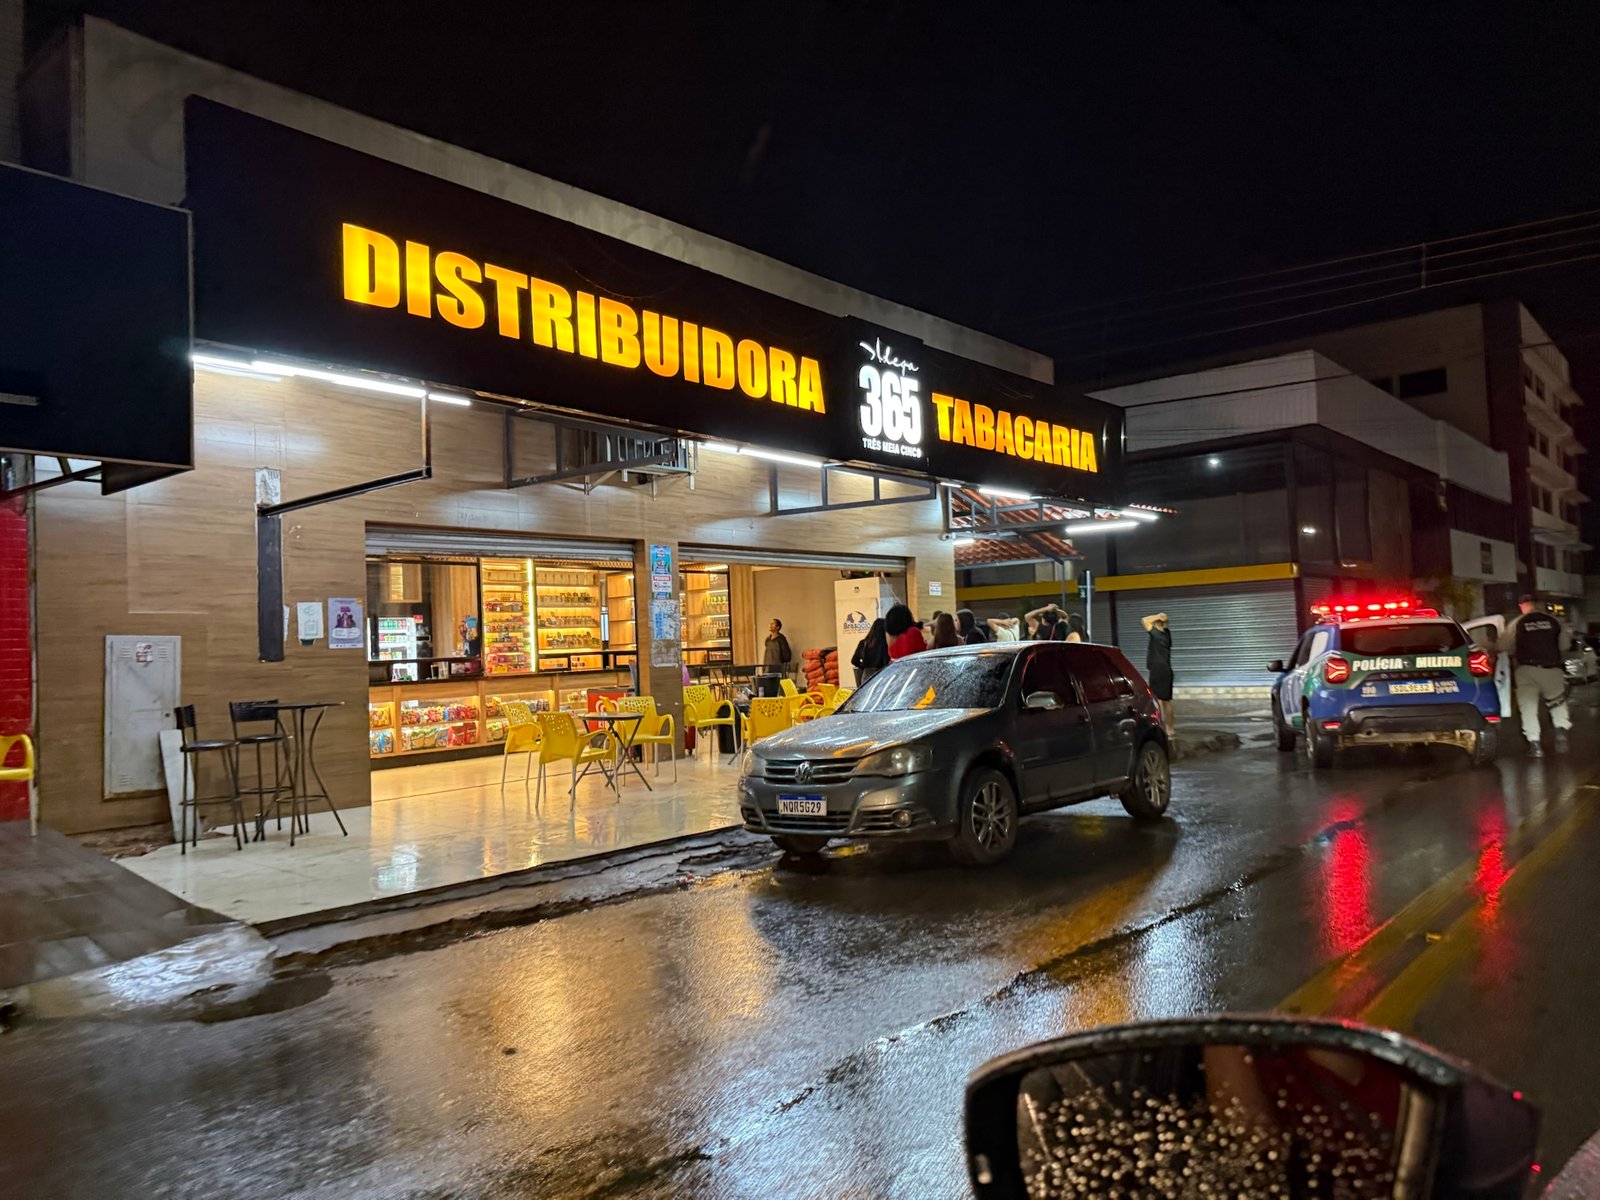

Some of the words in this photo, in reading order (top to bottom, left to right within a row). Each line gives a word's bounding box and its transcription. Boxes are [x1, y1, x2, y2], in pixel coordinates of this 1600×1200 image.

[342, 222, 826, 415] DISTRIBUIDORA
[858, 364, 922, 445] 365
[862, 437, 882, 452] TRÊS
[882, 441, 900, 455] MEIA
[900, 444, 922, 459] CINCO
[931, 392, 1098, 473] TABACARIA
[1352, 657, 1403, 672] POLÍCIA
[1415, 656, 1462, 668] MILITAR
[782, 801, 822, 813] NQR5G29
